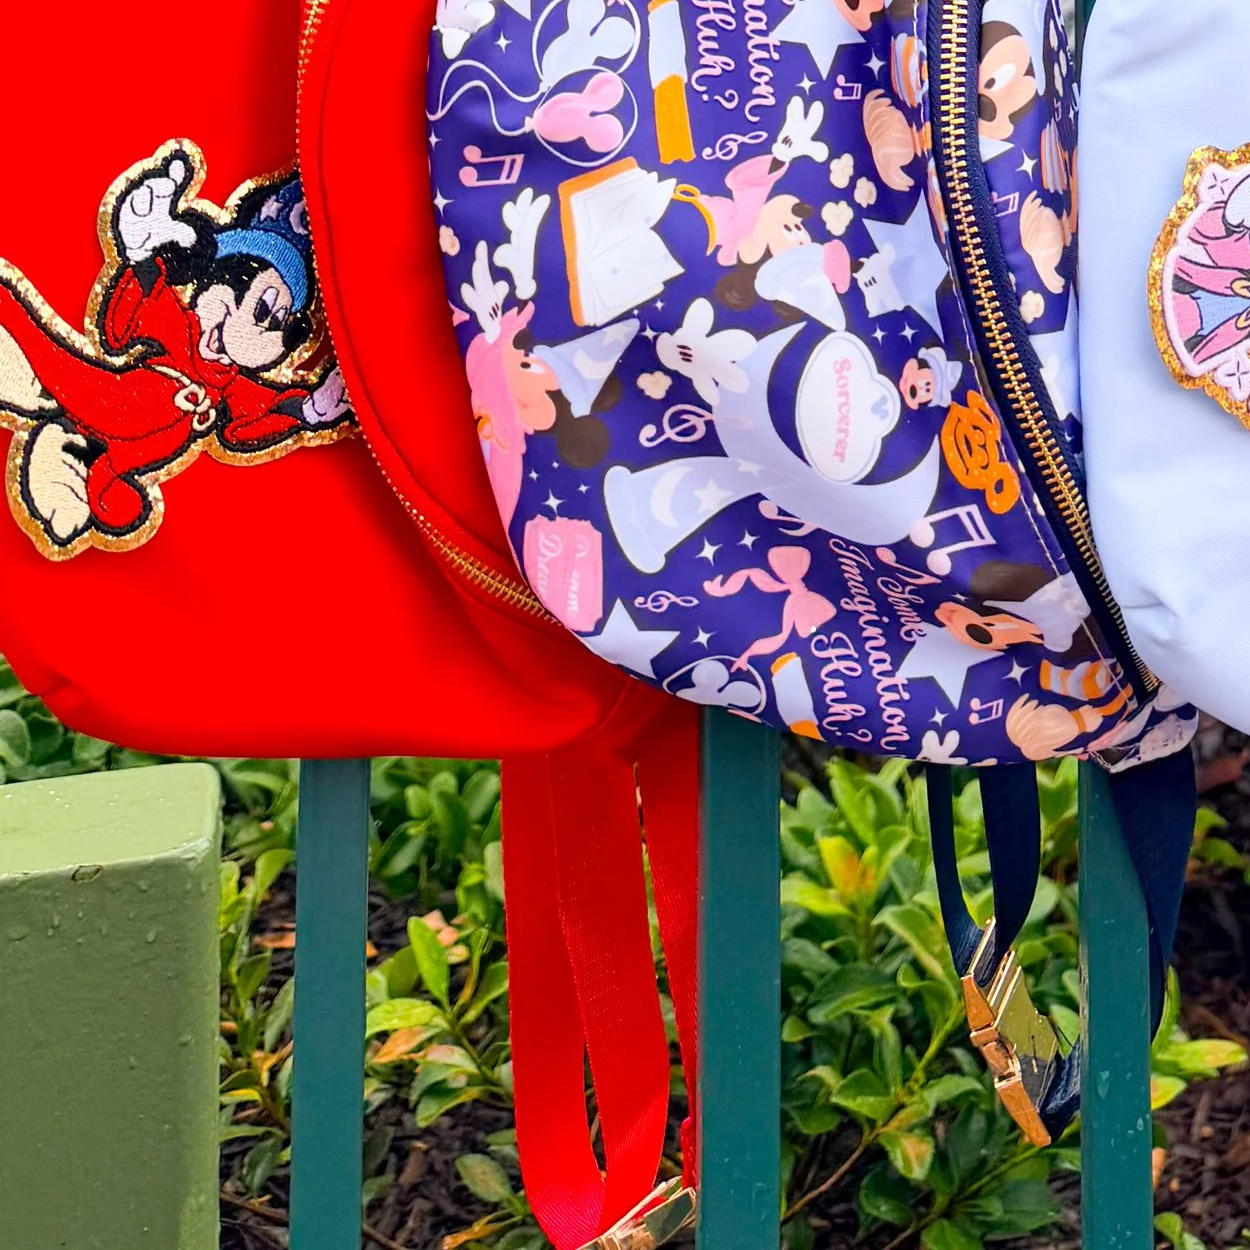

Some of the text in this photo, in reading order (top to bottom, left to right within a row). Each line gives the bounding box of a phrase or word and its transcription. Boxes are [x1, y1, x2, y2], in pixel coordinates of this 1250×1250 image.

[833, 357, 852, 463] Sorcerer
[829, 538, 911, 750] Imagination
[876, 576, 925, 642] Some
[810, 631, 873, 742] Huh?
